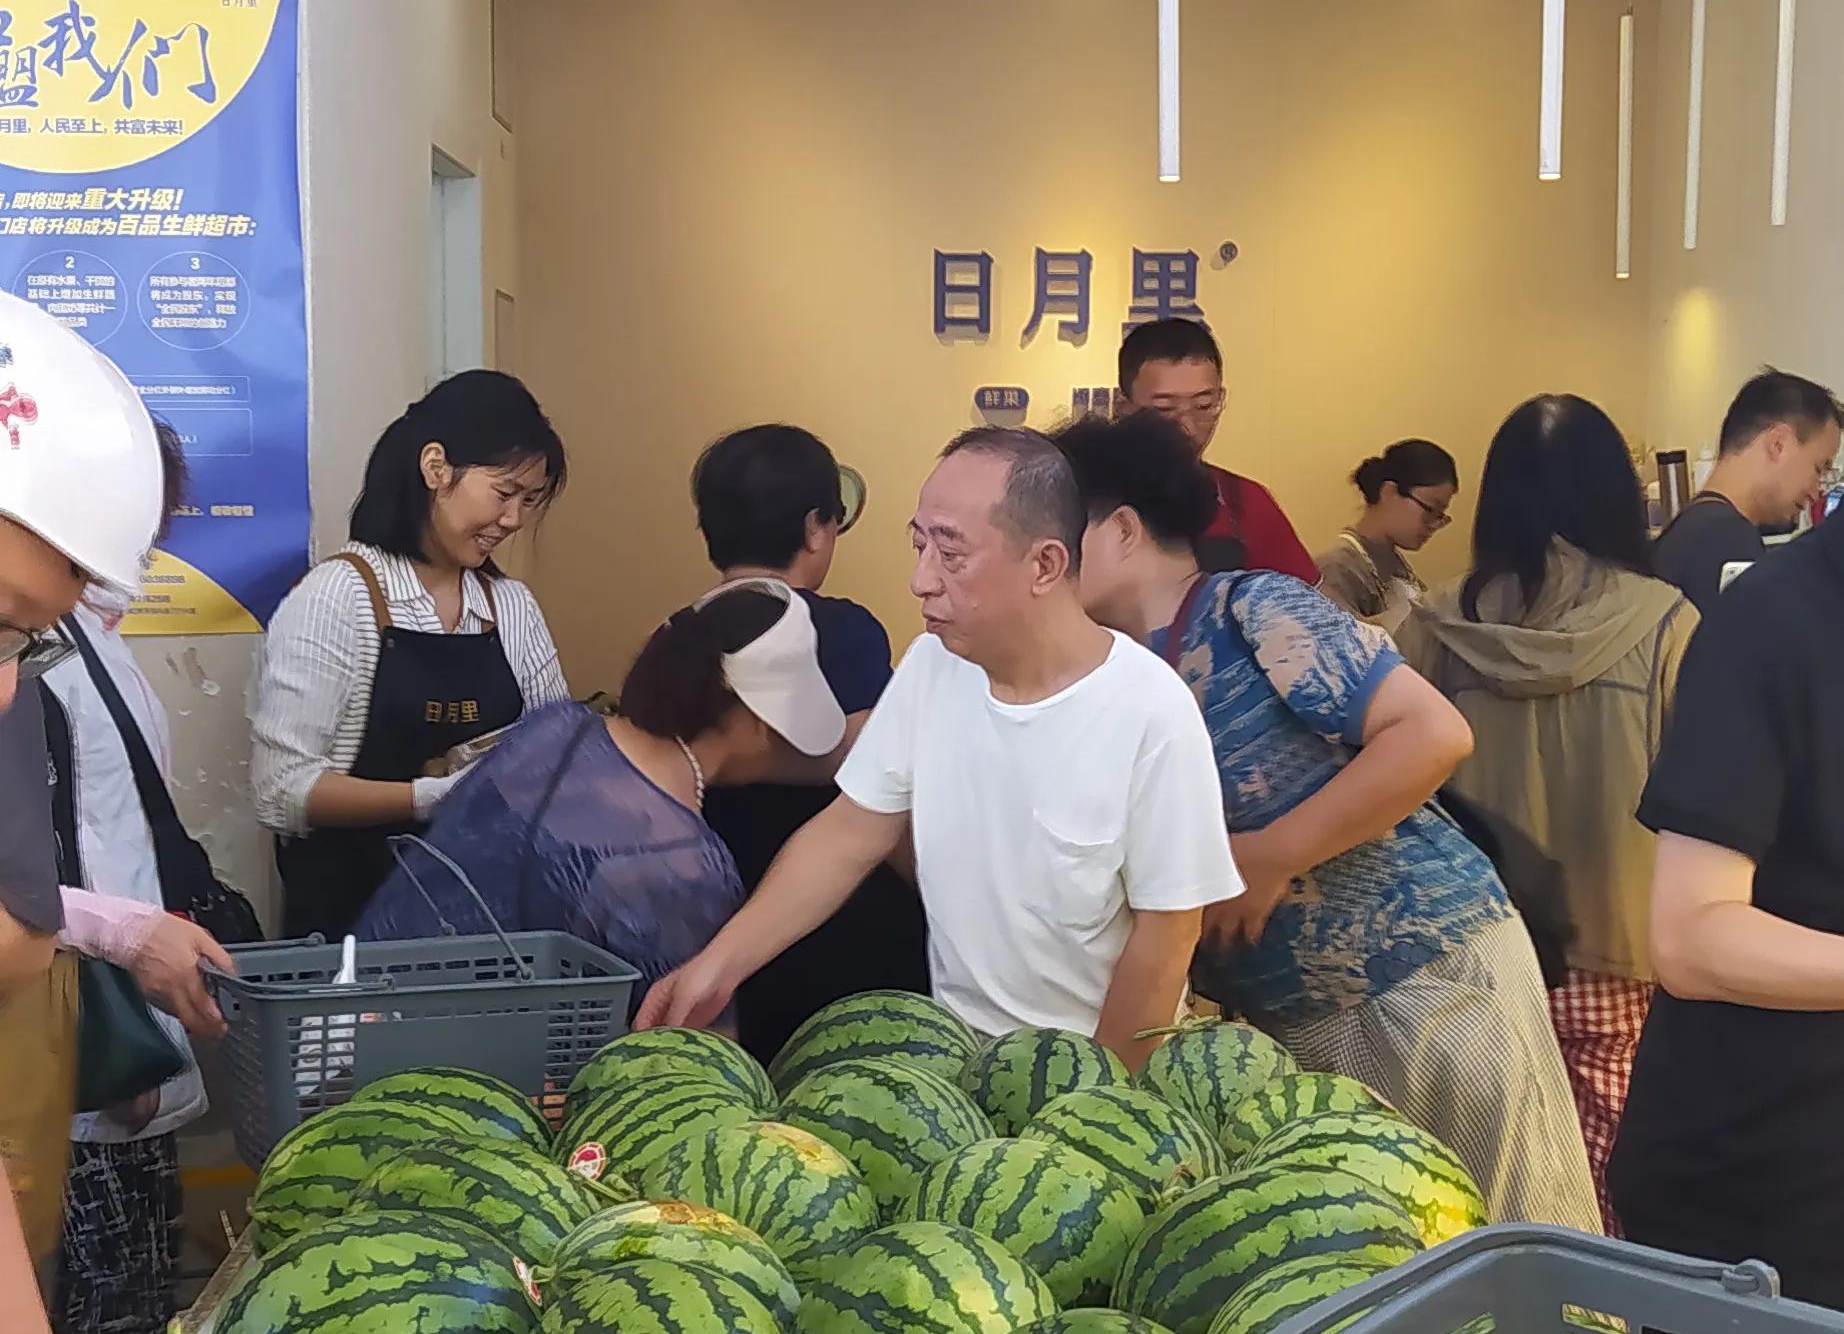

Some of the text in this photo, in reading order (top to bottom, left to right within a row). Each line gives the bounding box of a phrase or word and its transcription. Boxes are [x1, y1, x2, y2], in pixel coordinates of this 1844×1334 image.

[0, 0, 216, 109] 盟我们
[65, 256, 75, 269] 2
[190, 257, 201, 270] 3
[933, 246, 1212, 339] 日月里
[425, 700, 479, 723] 日月里
